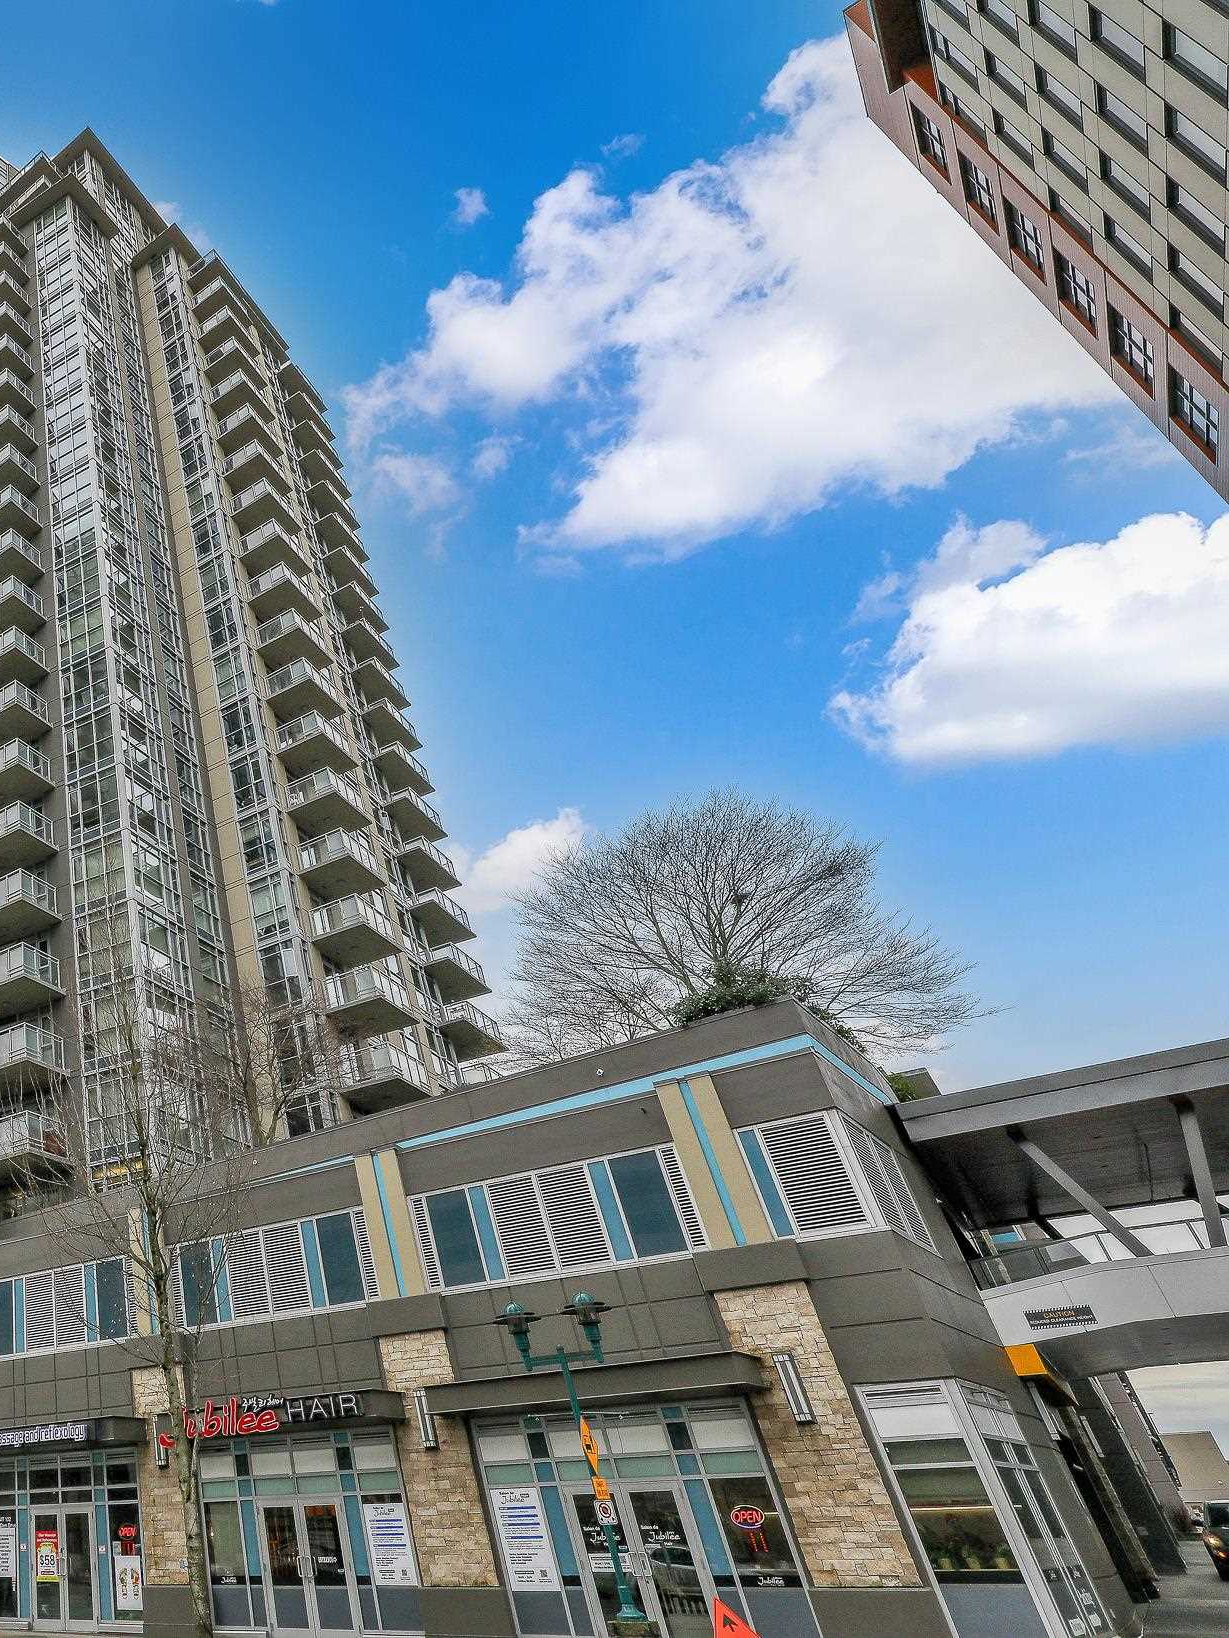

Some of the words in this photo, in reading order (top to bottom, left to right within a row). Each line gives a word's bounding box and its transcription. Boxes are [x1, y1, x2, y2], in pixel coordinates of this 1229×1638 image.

[1043, 1311, 1076, 1319] CAUTION
[286, 1393, 358, 1423] HAIR
[24, 1426, 39, 1444] and
[39, 1423, 86, 1442] reflexology
[733, 1510, 761, 1523] OPEN
[119, 1527, 137, 1537] OPEN
[648, 1531, 680, 1542] Jubilee
[39, 1554, 55, 1565] $58
